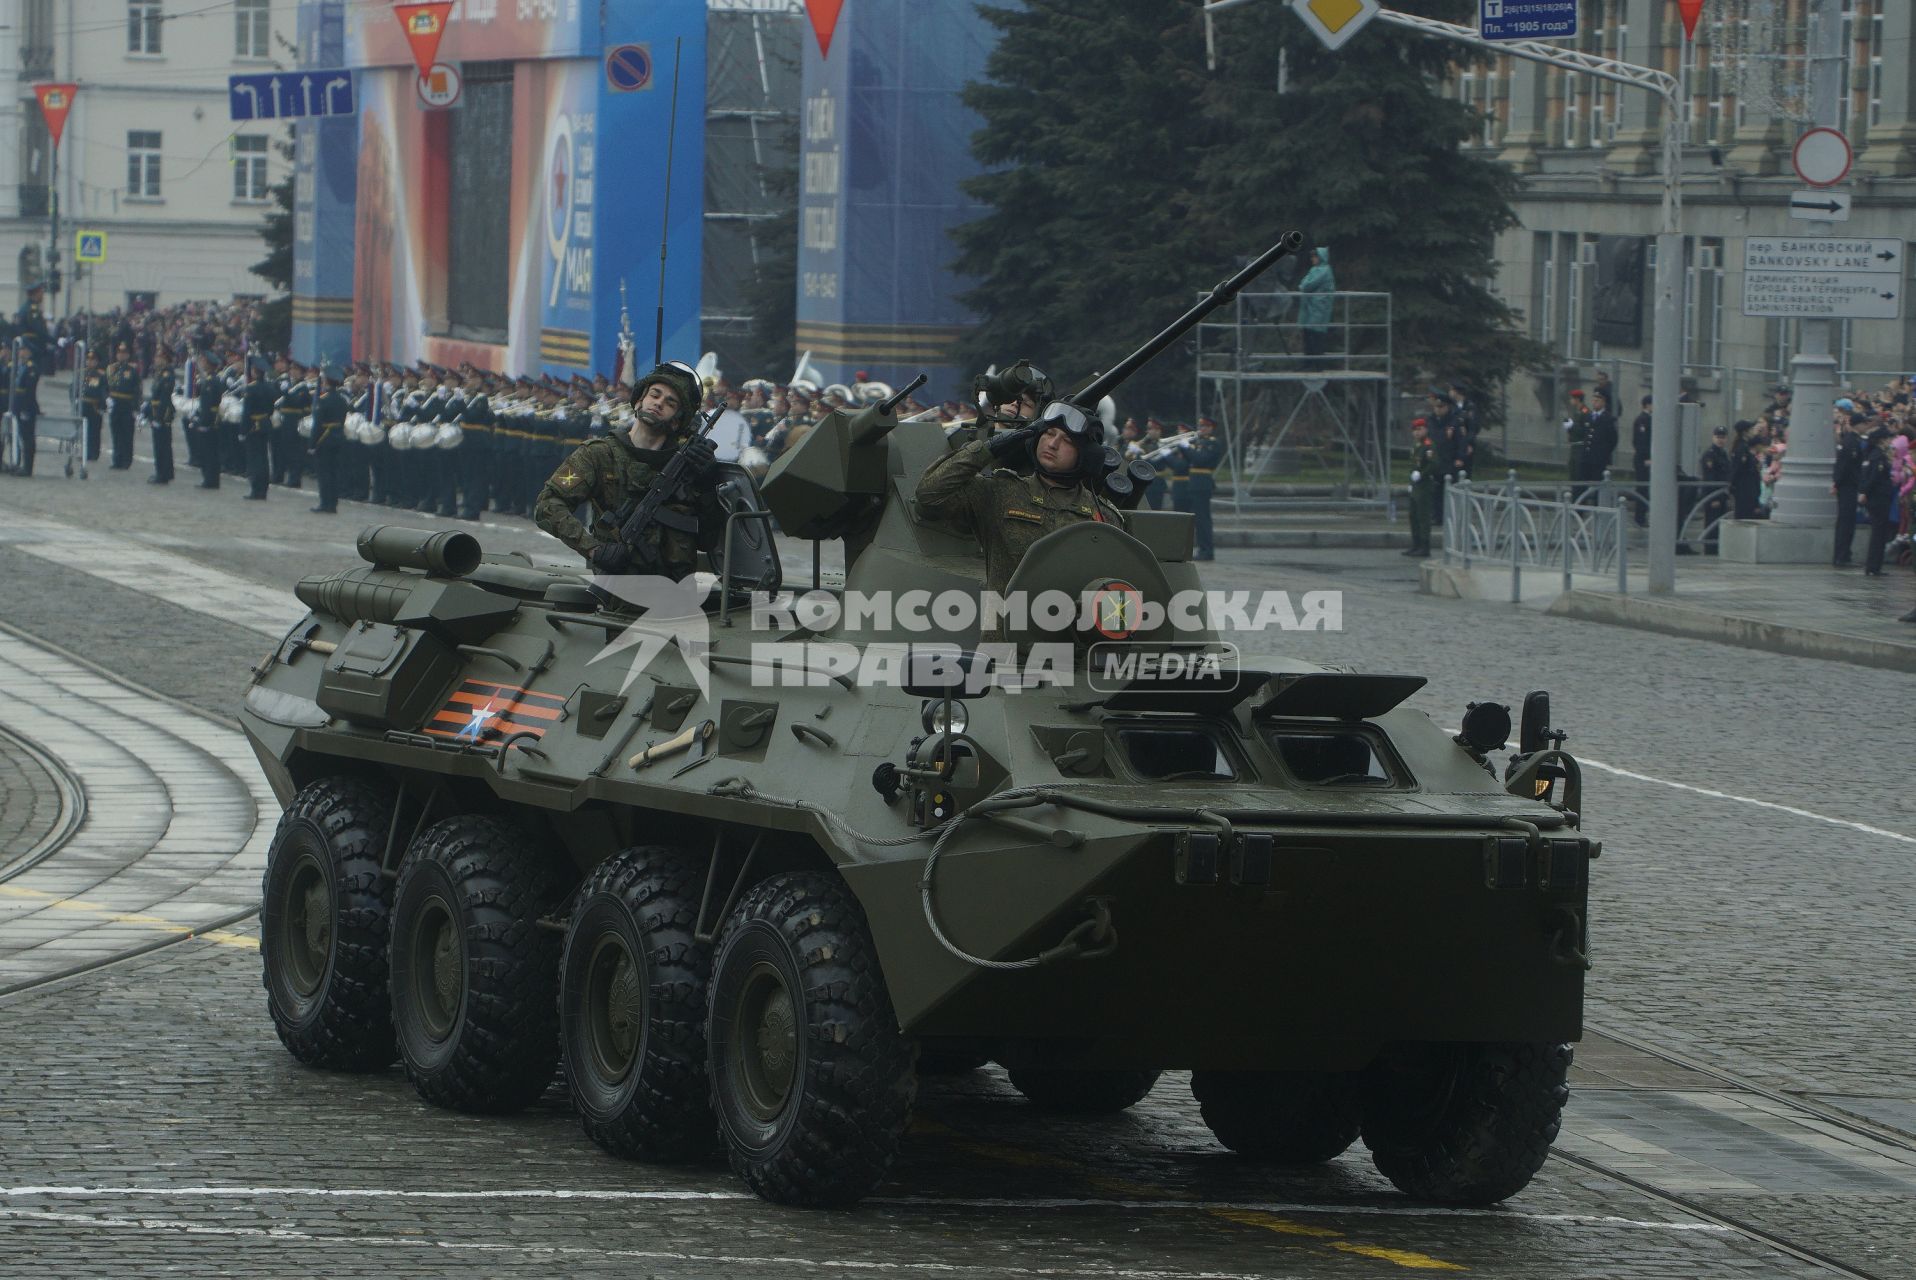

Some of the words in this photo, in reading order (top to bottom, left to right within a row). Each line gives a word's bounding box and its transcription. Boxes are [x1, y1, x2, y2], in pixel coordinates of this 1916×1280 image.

[1488, 2, 1500, 16] Т
[1485, 23, 1504, 34] Пл.
[546, 113, 575, 308] 9
[1780, 241, 1873, 254] БАНКОВСКИЙ
[1748, 255, 1829, 267] BANKOVSKY
[1835, 257, 1870, 268] LANE
[566, 247, 592, 293] МАЯ
[1748, 275, 1839, 284] АДМИНИСТРАЦИЯ
[1747, 284, 1788, 292] ГОРОДА
[1792, 285, 1877, 295] ЕКАТЕРИНБУРГА
[1828, 296, 1851, 304] CITY
[1747, 303, 1835, 313] ADMINISTRATION
